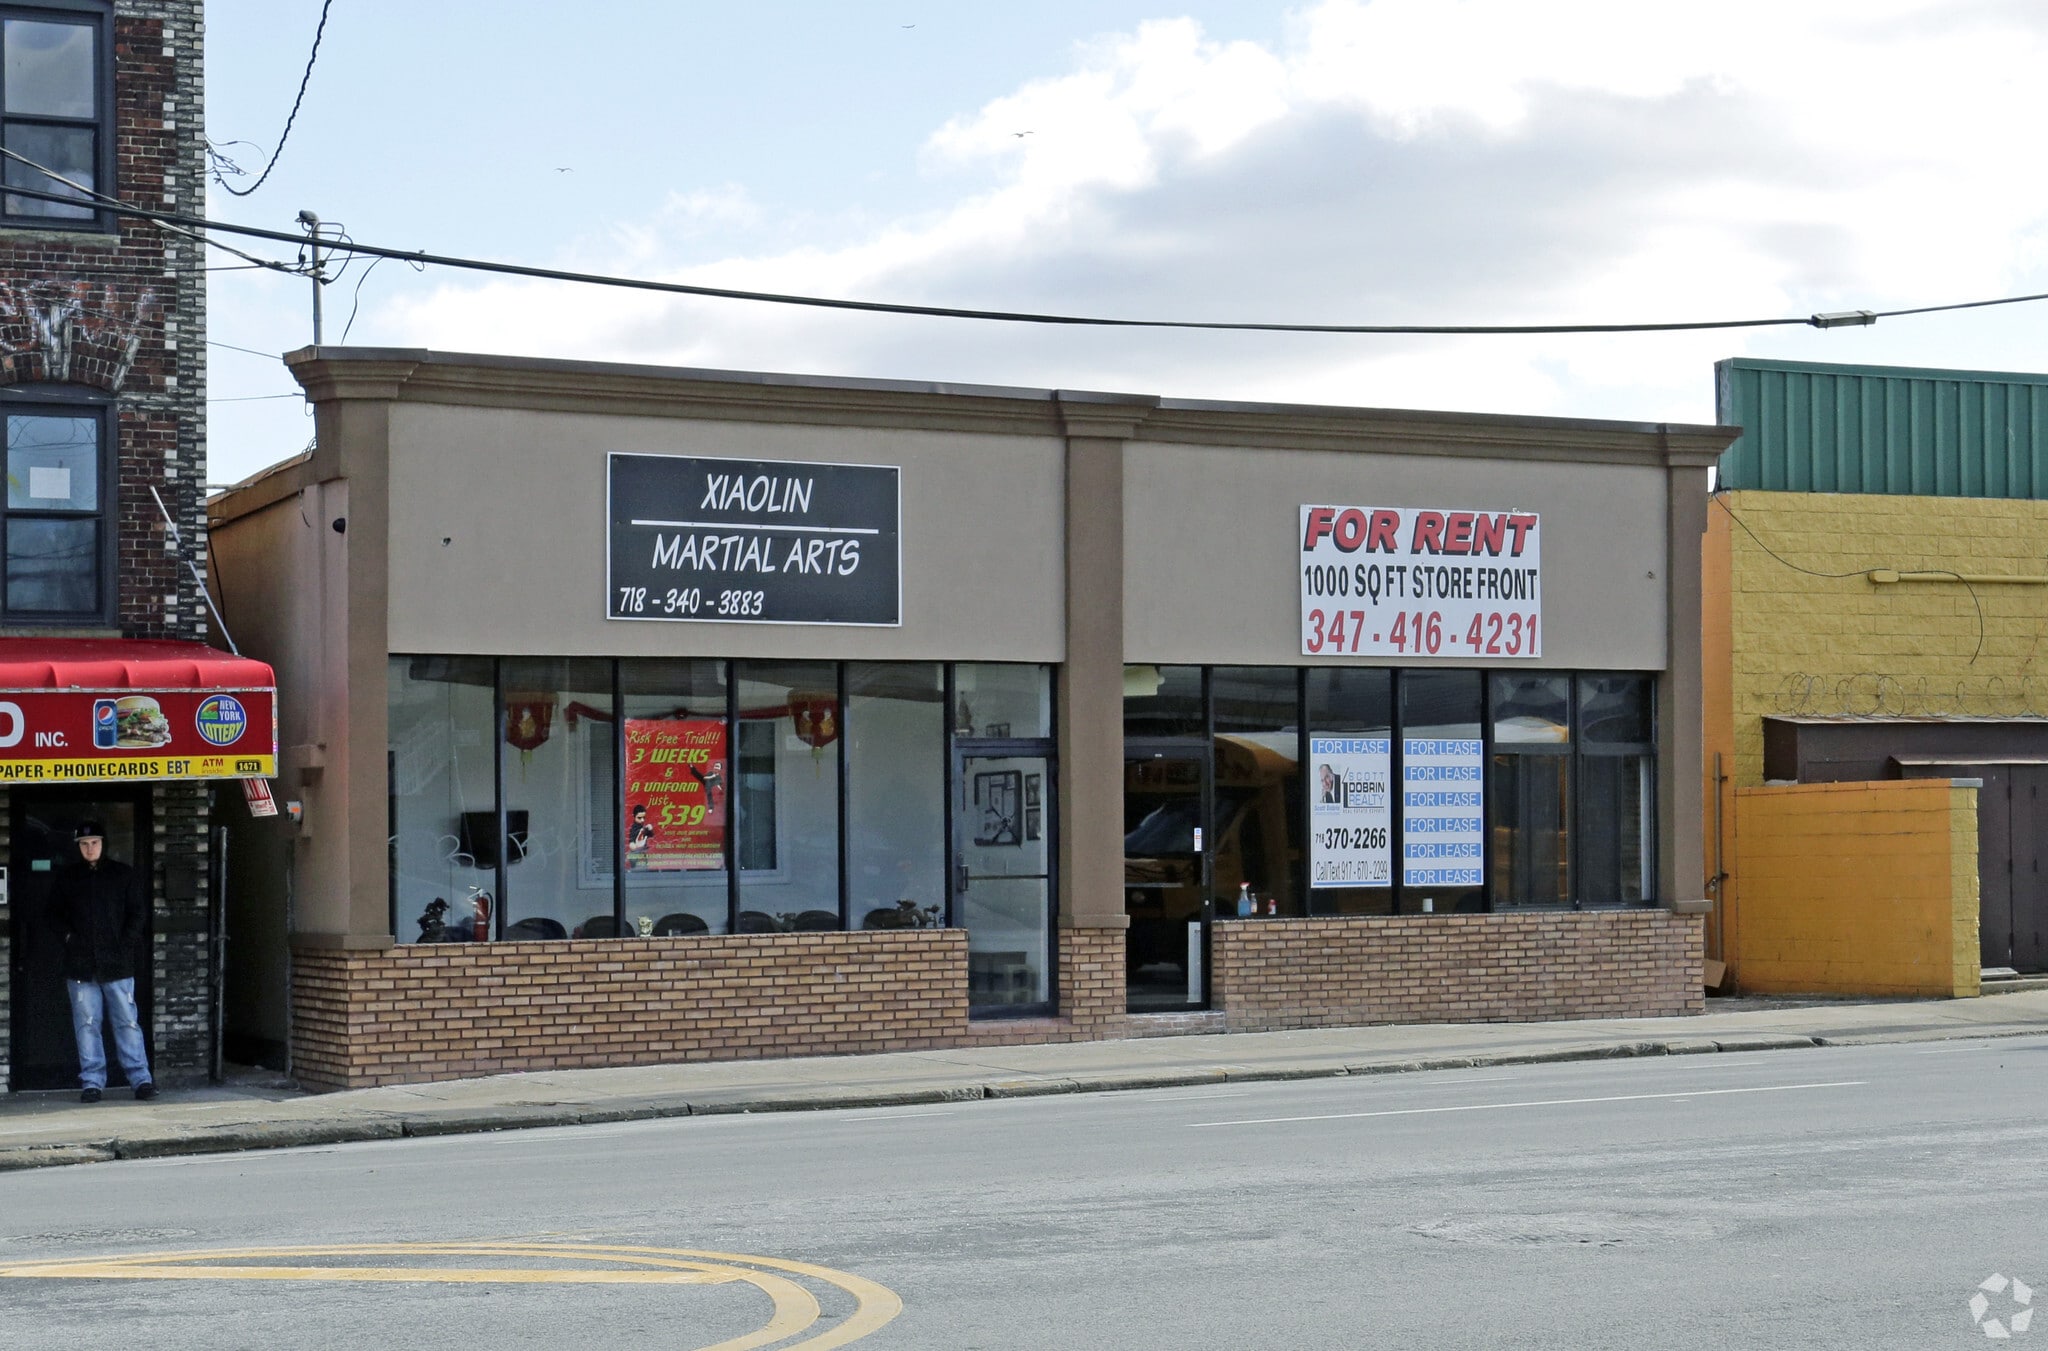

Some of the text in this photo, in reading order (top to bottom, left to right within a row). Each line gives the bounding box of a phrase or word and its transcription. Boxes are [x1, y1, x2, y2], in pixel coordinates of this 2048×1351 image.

[701, 474, 813, 513] XIAOLIN
[1303, 508, 1537, 557] FOR RENT
[652, 534, 860, 575] MARTIAL ARTS
[1305, 565, 1348, 597] 1000
[220, 700, 236, 710] NEW
[220, 711, 241, 720] YORK
[199, 722, 244, 742] LOTTERY
[629, 731, 721, 744] Risk Free Trial!!!
[35, 732, 68, 747] INC.
[1318, 740, 1384, 753] FOR LEASE
[1410, 742, 1477, 755] FOR LEASE
[632, 748, 710, 763] 3 WEEKS
[54, 761, 159, 777] PHONECARDS
[167, 760, 190, 774] EBT
[202, 758, 224, 767] ATM
[665, 767, 673, 778] &
[1349, 772, 1384, 781] SCOTT
[1410, 768, 1476, 780] FOR LEASE
[631, 782, 698, 792] A UNIFORM
[1349, 782, 1384, 793] DOBRIN
[1349, 794, 1384, 805] REALTY
[1410, 793, 1476, 806] FOR LEASE
[658, 803, 706, 828] $39
[1410, 819, 1476, 832] FOR LEASE
[1325, 828, 1386, 849] 370-2266
[1410, 844, 1476, 857] FOR LEASE
[1410, 870, 1476, 883] FOR LEASE
